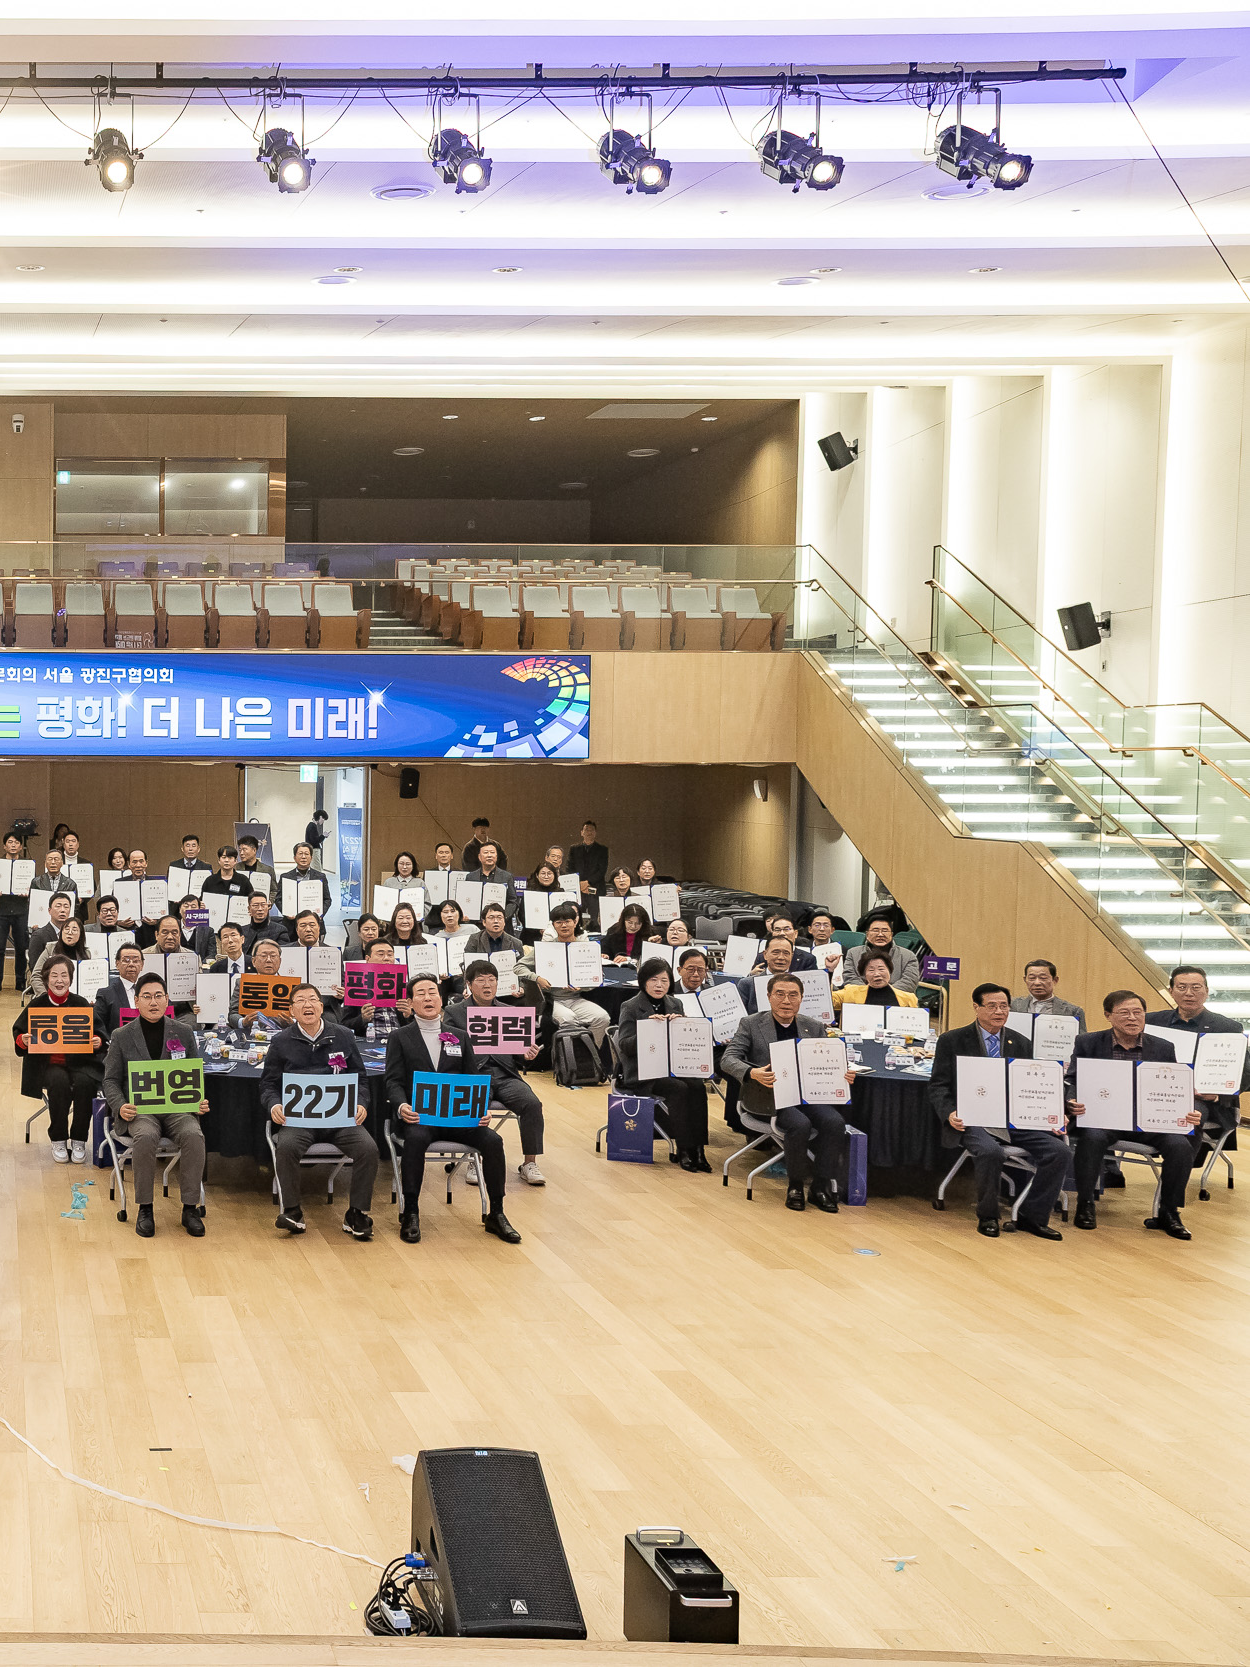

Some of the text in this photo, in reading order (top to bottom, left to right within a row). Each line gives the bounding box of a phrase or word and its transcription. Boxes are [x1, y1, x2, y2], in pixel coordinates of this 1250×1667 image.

[43, 667, 74, 684] 서울
[80, 667, 174, 684] 광진구협의회
[36, 696, 127, 739] 평화!
[142, 697, 180, 739] 더
[196, 697, 273, 739] 나은
[287, 697, 379, 739] 미래!
[346, 970, 406, 1000] 평화
[468, 1014, 532, 1047] 협력
[131, 1068, 201, 1106] 번영
[284, 1083, 356, 1119] 22기
[415, 1082, 488, 1119] 미래
